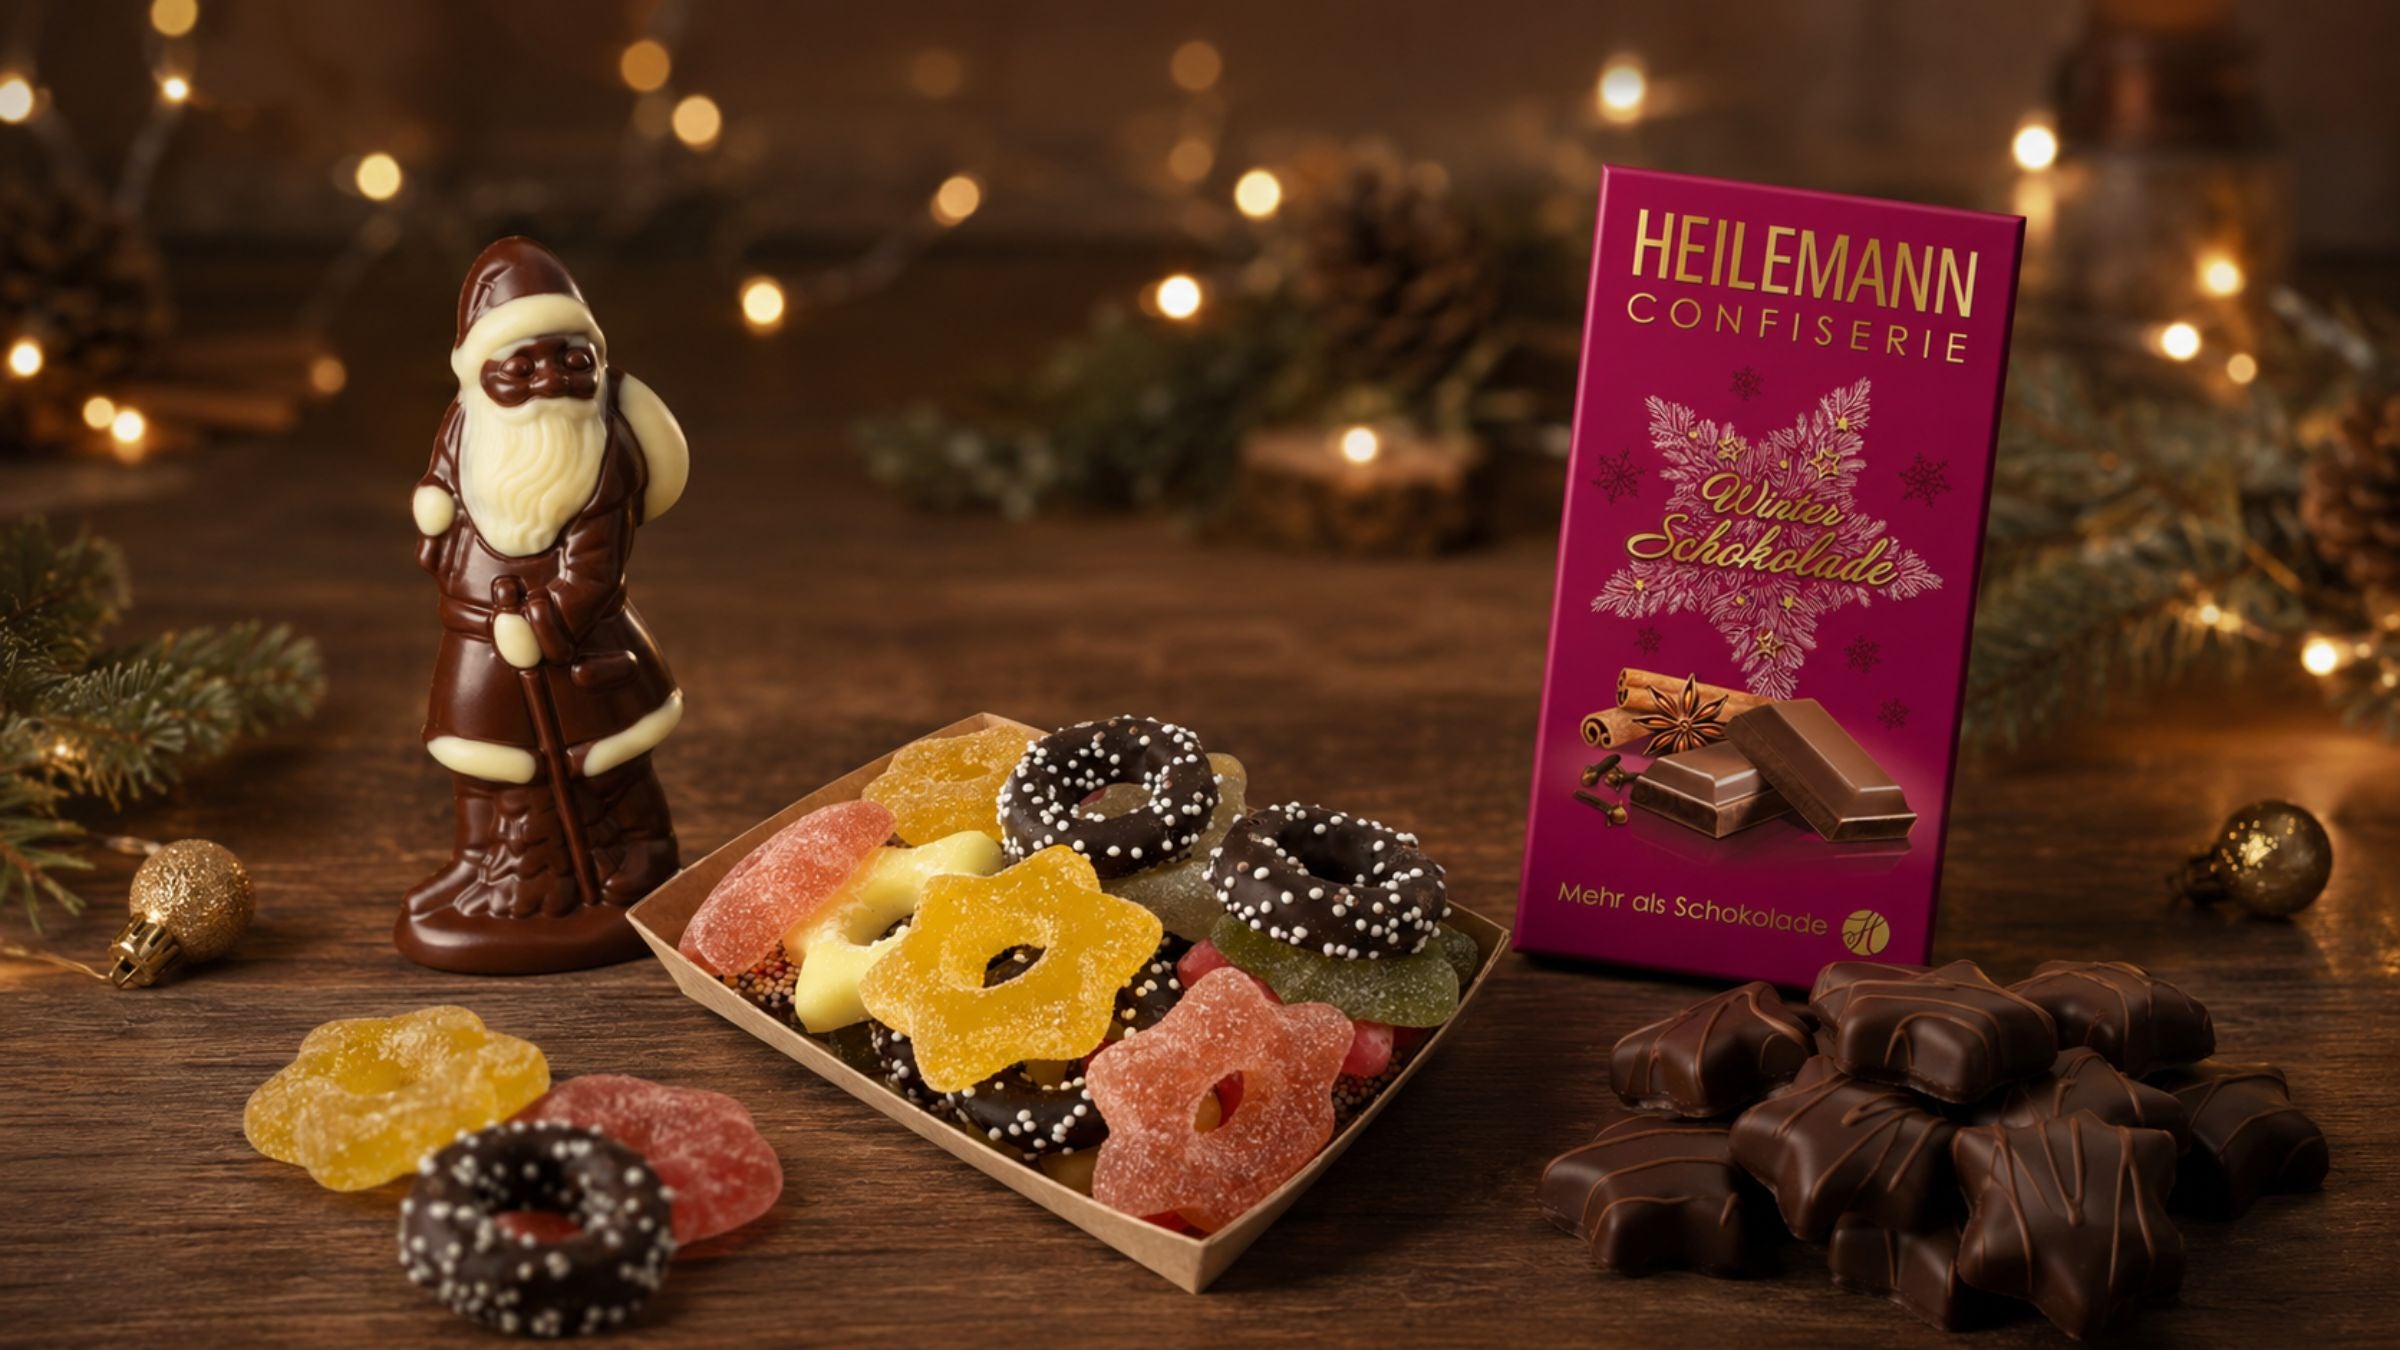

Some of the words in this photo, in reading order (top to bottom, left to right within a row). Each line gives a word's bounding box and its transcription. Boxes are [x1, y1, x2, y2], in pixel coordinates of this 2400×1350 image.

[1632, 208, 1979, 318] HEILEMANN
[1627, 292, 1969, 364] CONFISERIE
[1701, 472, 1847, 527] Winter
[1625, 513, 1899, 586] Schokolade
[1557, 881, 1625, 908] Mehr
[1632, 892, 1666, 915] als
[1673, 895, 1829, 936] Schokolade
